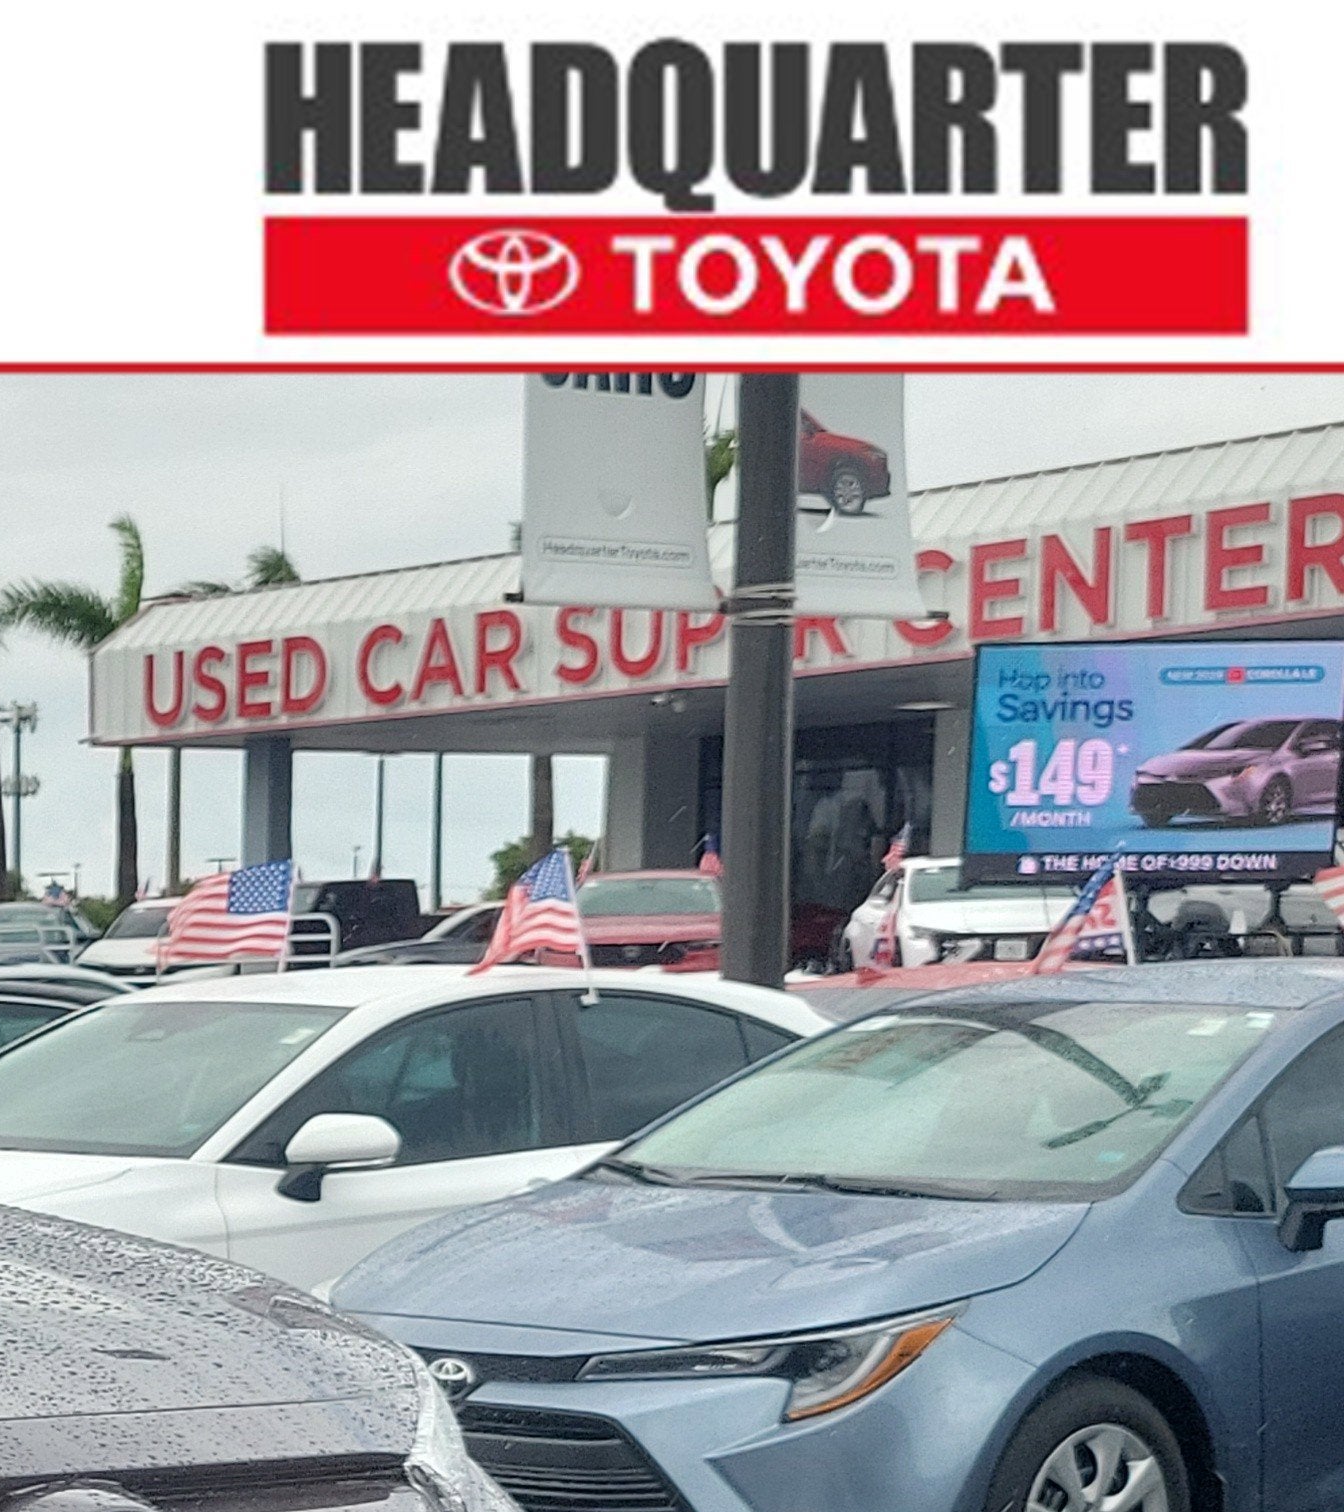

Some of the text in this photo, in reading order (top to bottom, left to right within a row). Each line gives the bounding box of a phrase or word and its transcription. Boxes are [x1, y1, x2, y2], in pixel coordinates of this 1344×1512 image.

[143, 635, 328, 729] USED
[355, 608, 524, 706] CAR
[554, 587, 849, 685] SUPR
[1058, 667, 1106, 690] into
[996, 691, 1134, 728] Savings
[1043, 853, 1080, 871] THE
[1141, 854, 1168, 870] OF
[1215, 854, 1278, 870] DOWN
